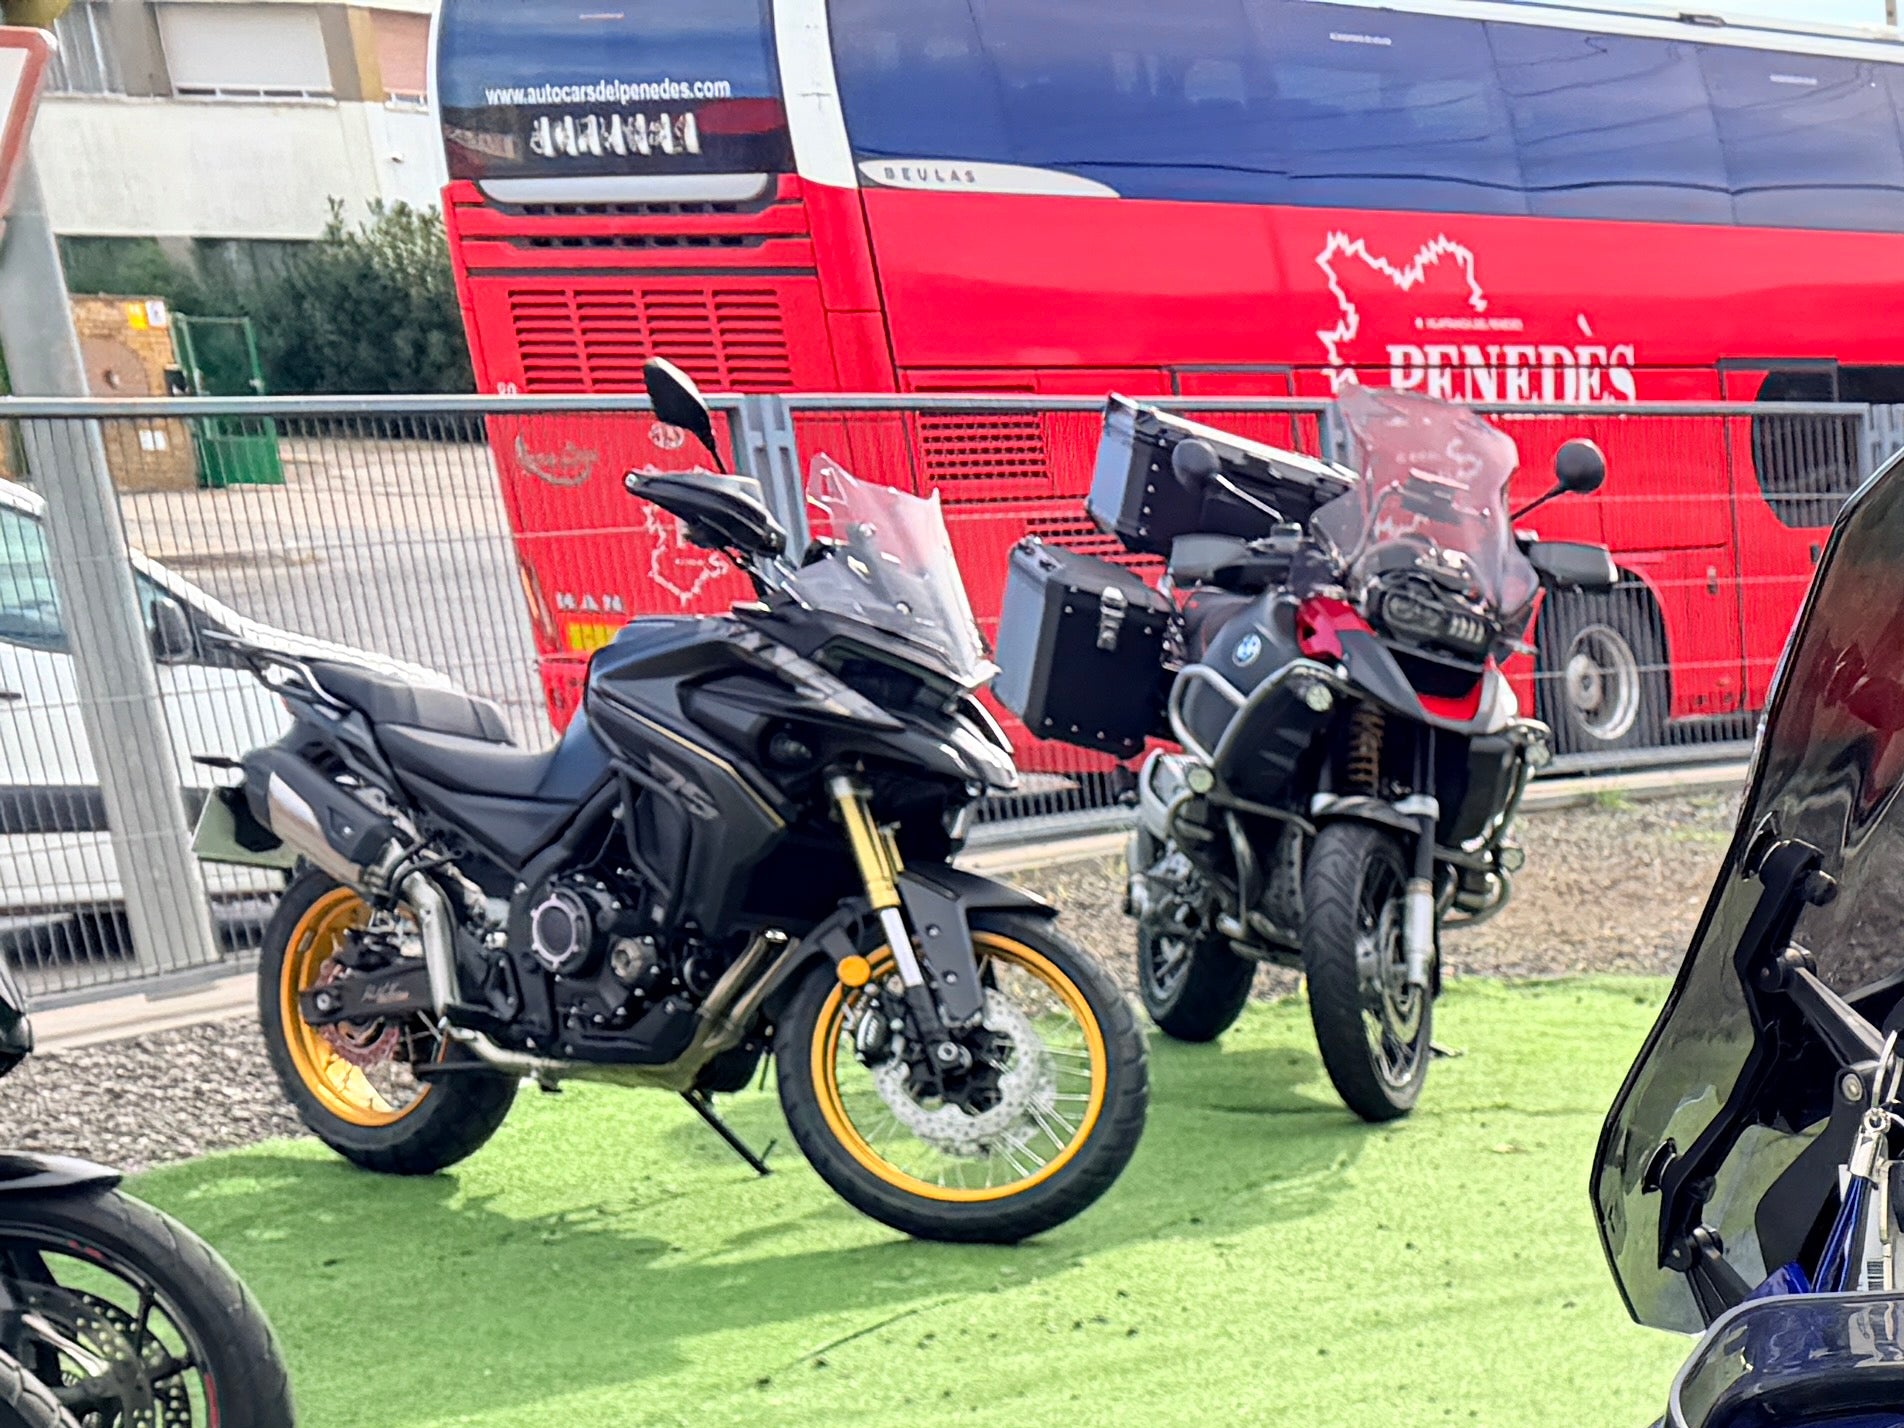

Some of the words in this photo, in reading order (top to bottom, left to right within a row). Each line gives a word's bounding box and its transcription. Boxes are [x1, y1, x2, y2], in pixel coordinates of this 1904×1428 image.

[484, 79, 731, 107] www.autocarsdelpenedes.com
[883, 166, 976, 184] BEULAS
[1385, 312, 1637, 405] PENEDÈS
